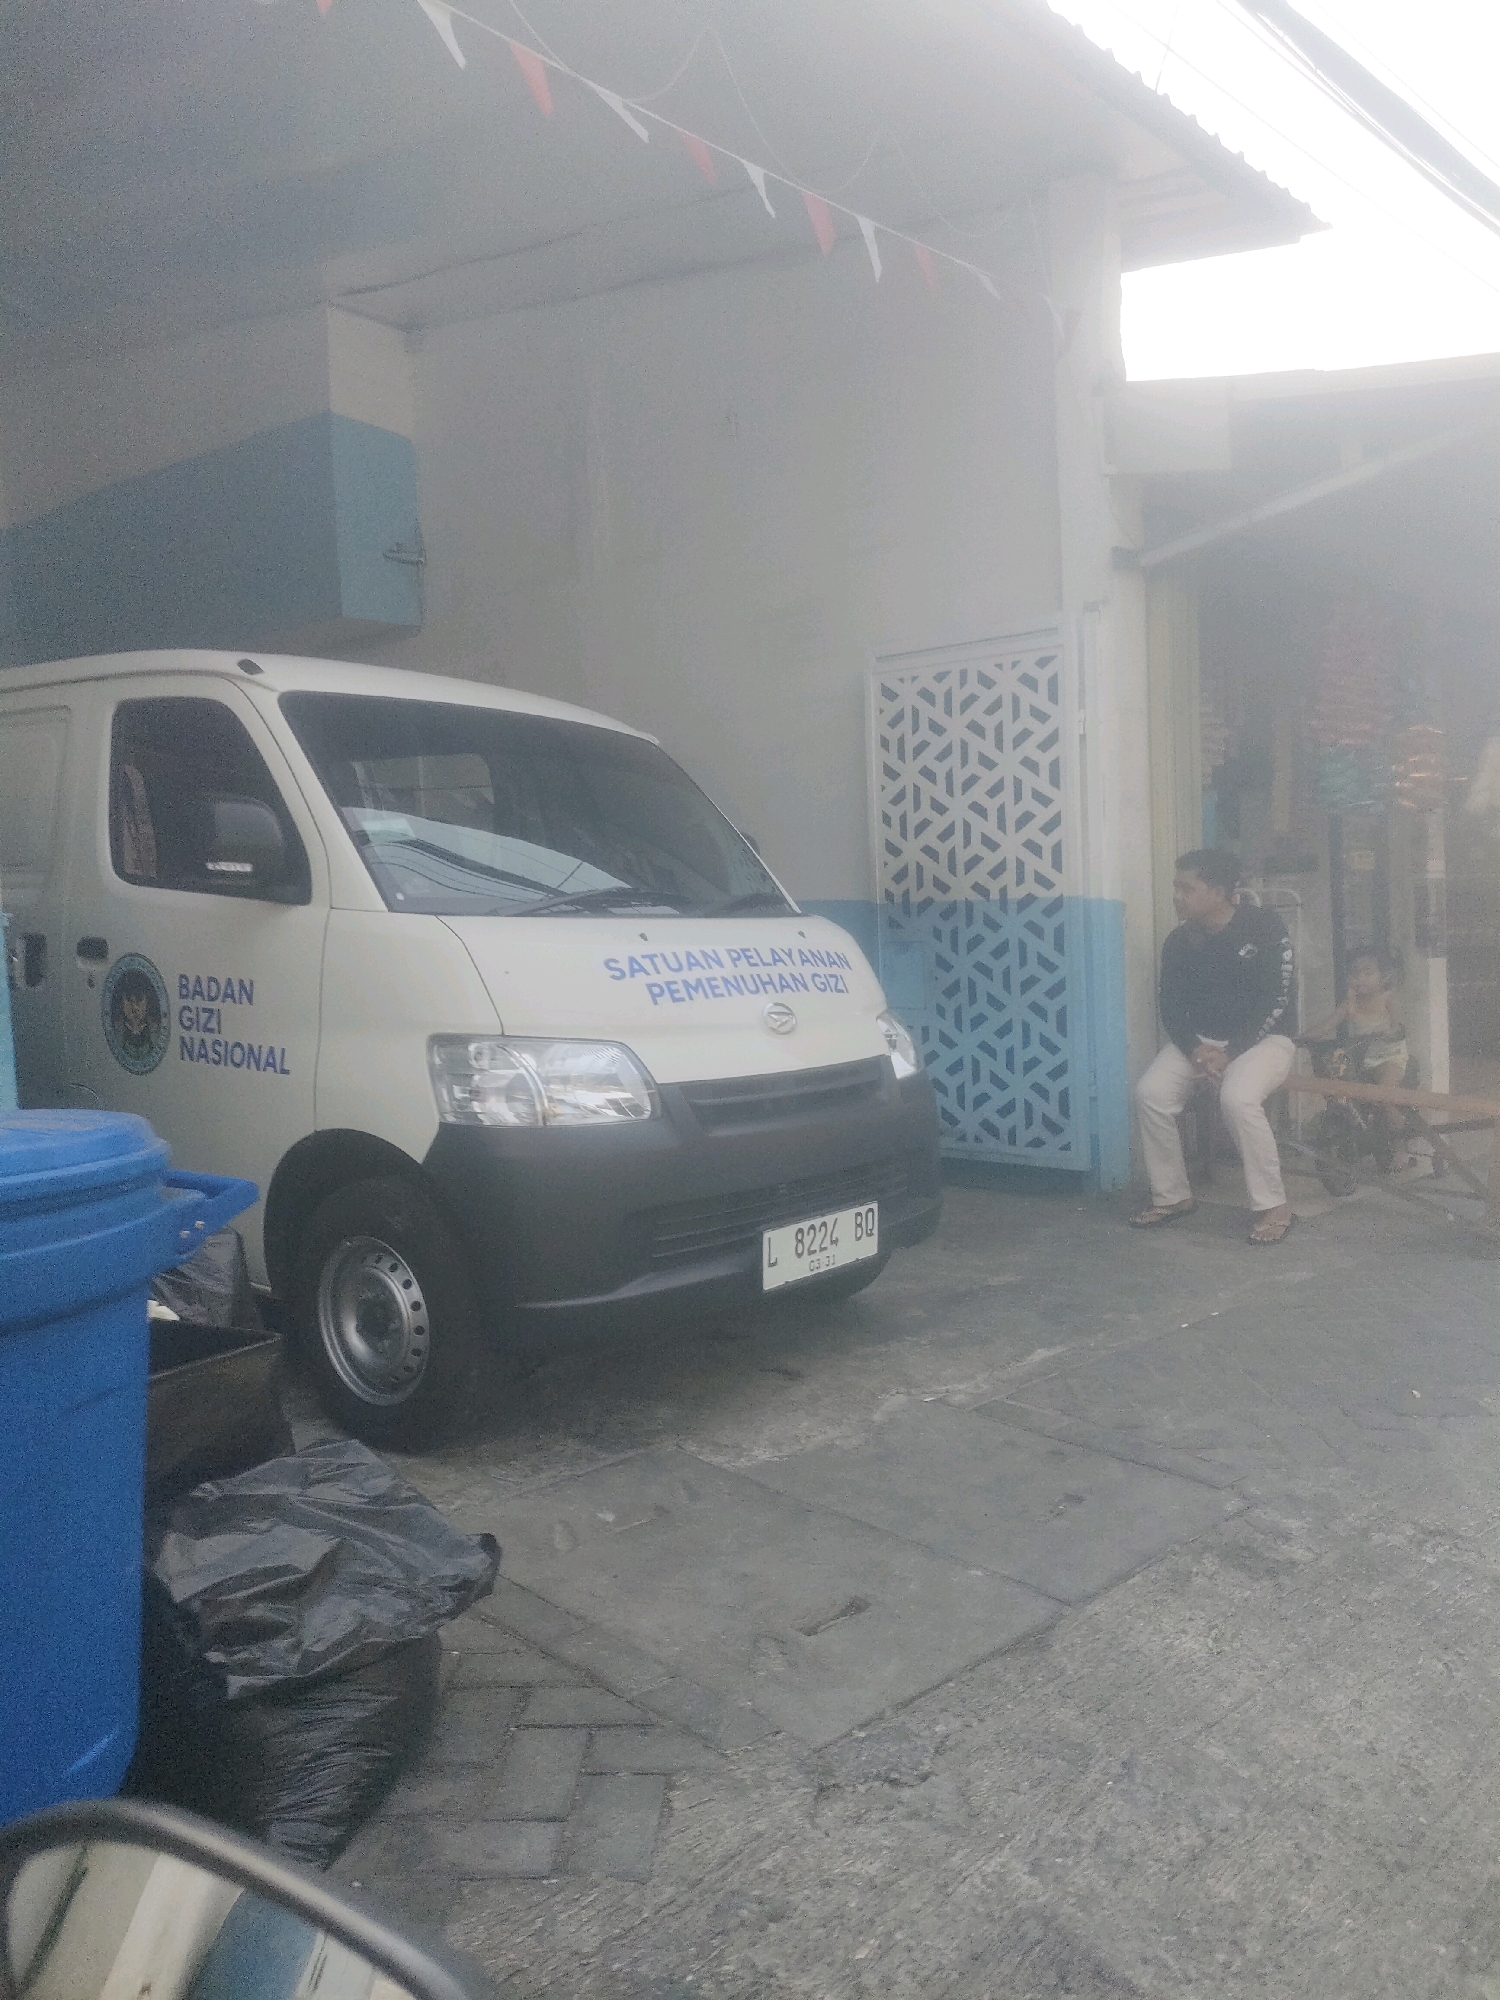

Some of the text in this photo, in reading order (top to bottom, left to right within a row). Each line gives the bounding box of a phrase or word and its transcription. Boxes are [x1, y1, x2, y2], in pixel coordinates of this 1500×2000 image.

[604, 947, 853, 981] SATUAN PELAYANAN
[178, 973, 254, 1006] BADAN
[645, 972, 849, 1006] PEMENUHAN GIZI
[178, 1005, 222, 1034] GIZI
[179, 1036, 291, 1075] NASIONAL
[767, 1207, 875, 1267] L 8224 BQ
